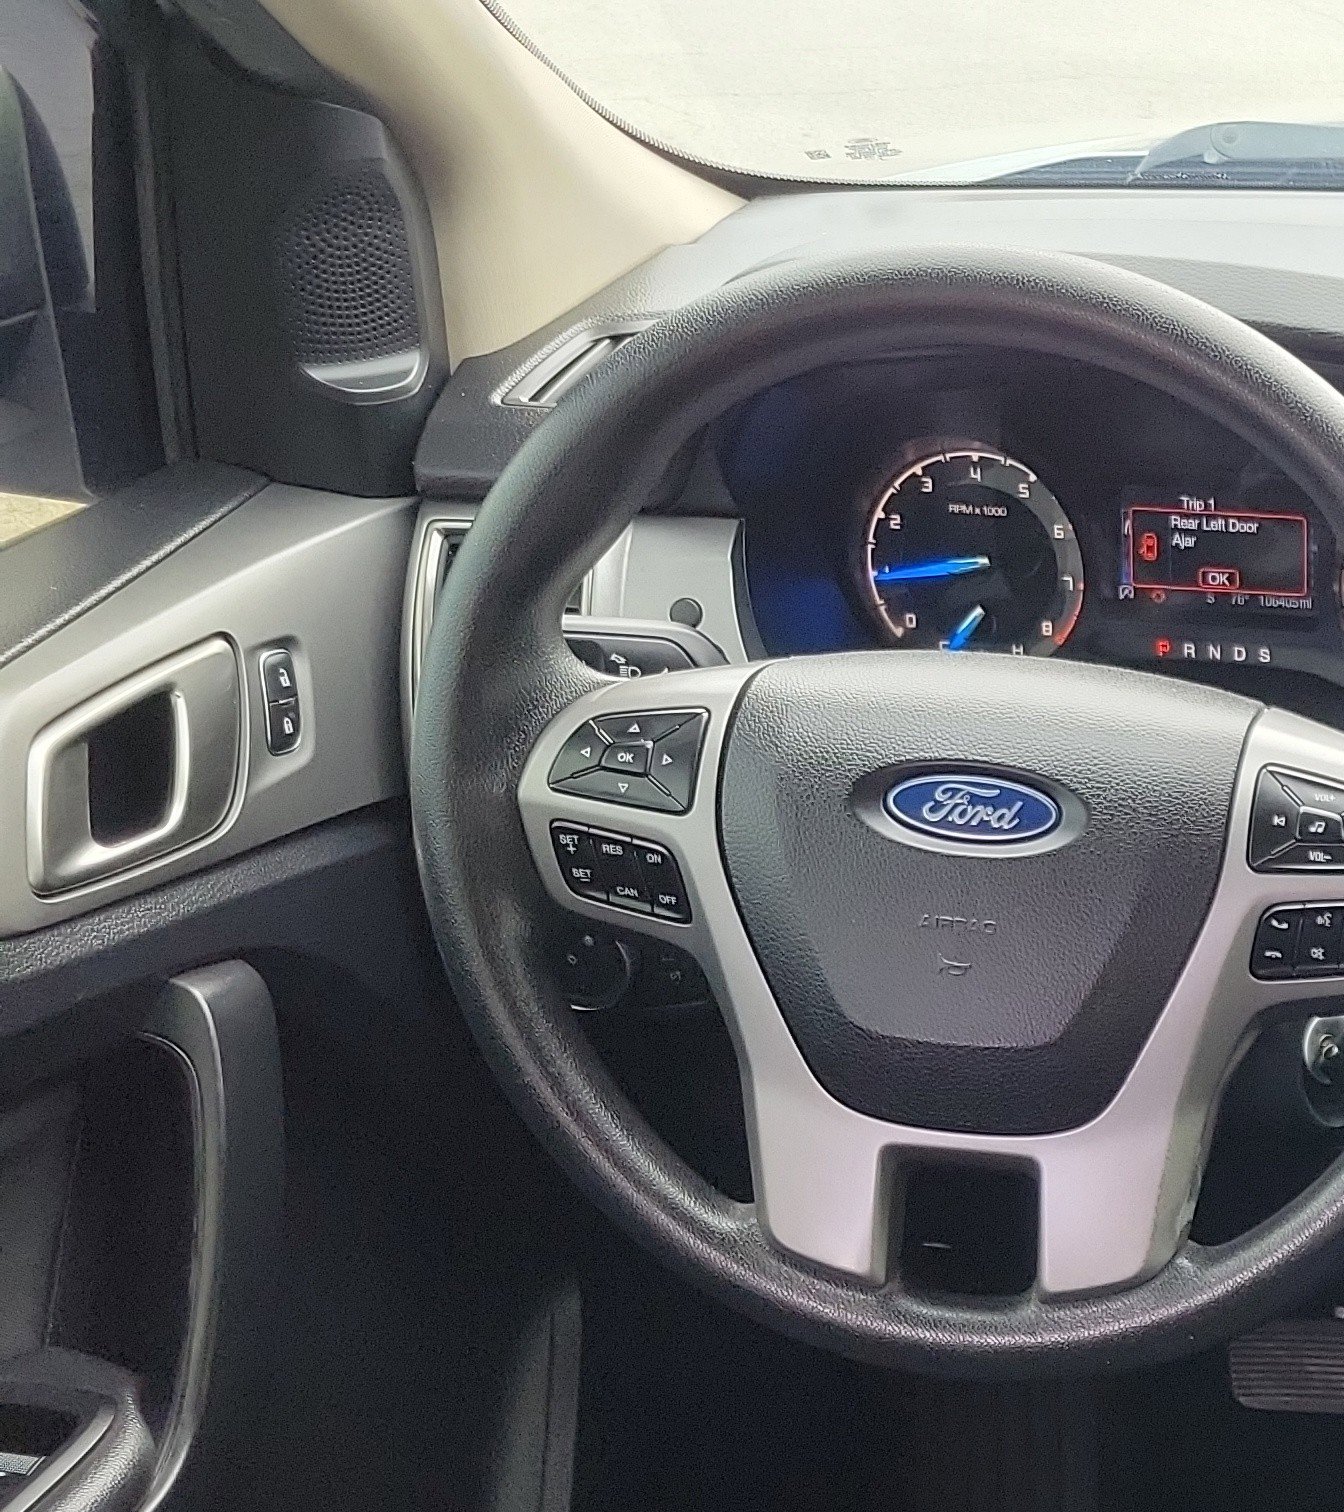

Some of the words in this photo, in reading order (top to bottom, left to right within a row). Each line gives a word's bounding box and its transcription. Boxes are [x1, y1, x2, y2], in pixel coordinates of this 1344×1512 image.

[970, 467, 981, 482] 4
[921, 477, 933, 493] 3
[1019, 484, 1030, 498] 5
[949, 503, 974, 515] RPM
[982, 506, 1008, 517] 1000
[1180, 497, 1205, 512] Trip
[1208, 498, 1215, 512] 1
[889, 515, 901, 529] 2
[1171, 516, 1200, 530] Rear
[1202, 517, 1227, 532] Left
[1229, 519, 1259, 534] Door
[1053, 525, 1065, 539] 6
[1172, 536, 1196, 550] Ajar
[1061, 574, 1074, 591] 7
[1208, 573, 1230, 586] OK
[905, 614, 917, 628] 0
[1041, 621, 1053, 635] 8
[1157, 641, 1170, 656] P
[1184, 644, 1196, 659] R
[1209, 645, 1221, 660] N
[1234, 647, 1246, 662] D
[1259, 648, 1271, 663] S
[617, 752, 634, 763] OK
[922, 783, 1024, 831] Ford
[559, 834, 579, 845] SET
[602, 844, 623, 856] RES
[646, 853, 662, 864] ON
[572, 867, 592, 879] SET
[616, 886, 639, 898] CAN
[659, 894, 677, 905] OFF
